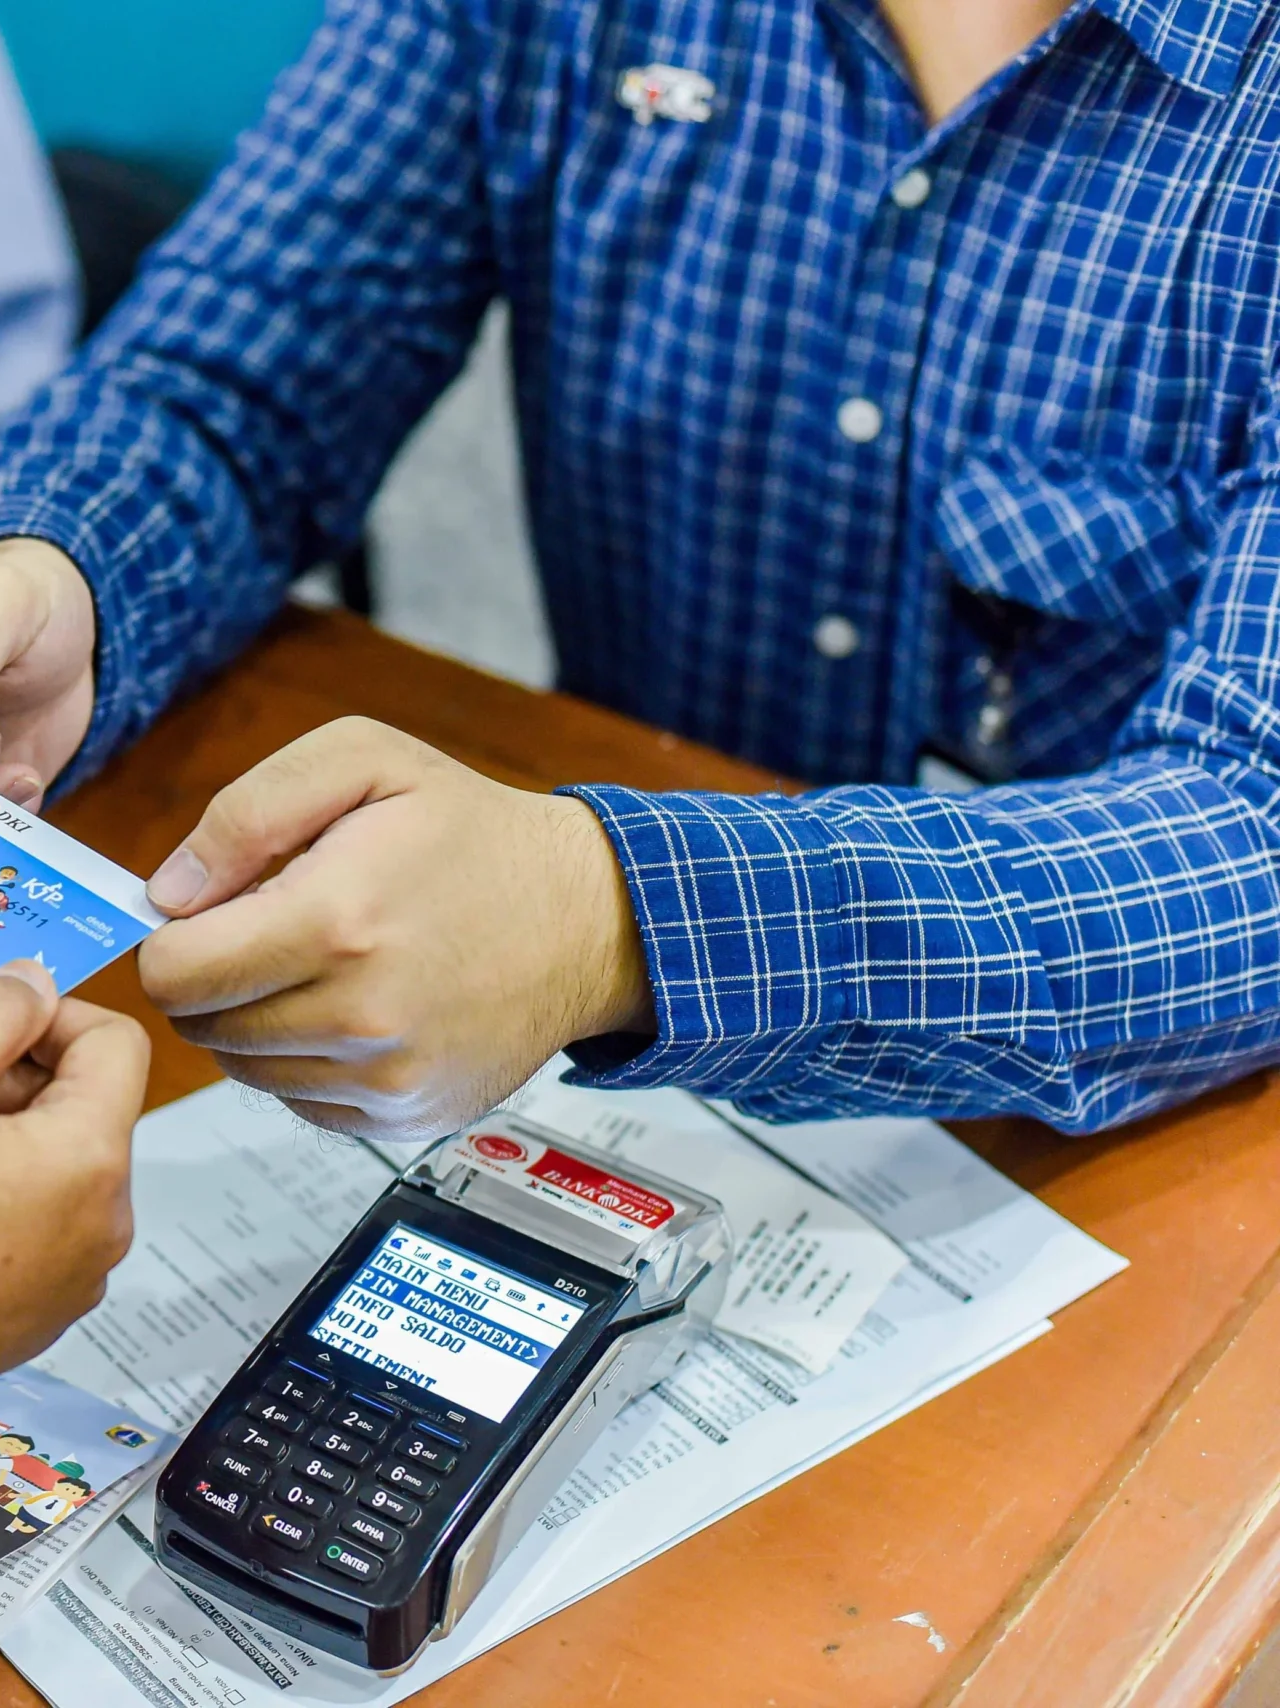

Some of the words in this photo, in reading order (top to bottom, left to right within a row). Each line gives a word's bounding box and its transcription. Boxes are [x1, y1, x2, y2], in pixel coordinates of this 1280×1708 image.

[6, 901, 48, 929] 6511
[542, 1169, 602, 1200] BANK
[616, 1202, 660, 1225] DKI
[355, 1268, 399, 1297] PIN
[372, 1252, 429, 1283] MAIN
[434, 1278, 490, 1312] MENU
[553, 1277, 587, 1299] D210
[326, 1306, 379, 1340] VOID
[342, 1288, 395, 1321] INFO
[400, 1314, 467, 1355] SALDO
[312, 1326, 438, 1390] SETTLEMENT
[281, 1381, 294, 1396] 1
[261, 1405, 277, 1419] 4
[273, 1412, 289, 1423] ghi
[342, 1411, 360, 1427] 2
[356, 1420, 374, 1432] abc
[243, 1428, 259, 1444] 7
[253, 1436, 270, 1447] prs
[325, 1434, 341, 1449] 5
[408, 1441, 424, 1456] 3
[421, 1448, 438, 1461] def
[223, 1457, 252, 1477] FUNC
[306, 1460, 322, 1475] 8
[390, 1466, 406, 1481] 6
[403, 1474, 422, 1487] mno
[204, 1491, 238, 1515] CANCEL
[287, 1486, 302, 1503] 0
[372, 1491, 387, 1507] 9
[385, 1499, 404, 1513] wxy
[272, 1518, 303, 1541] CLEAR
[351, 1519, 385, 1542] ALPHA
[339, 1552, 370, 1574] ENTER
[95, 1578, 113, 1596] Bank
[228, 1627, 267, 1666] NASABAH
[253, 1632, 281, 1658] Lengkap
[263, 1662, 289, 1687] DATA
[280, 1657, 300, 1677] Nama
[187, 1671, 205, 1688] Anda
